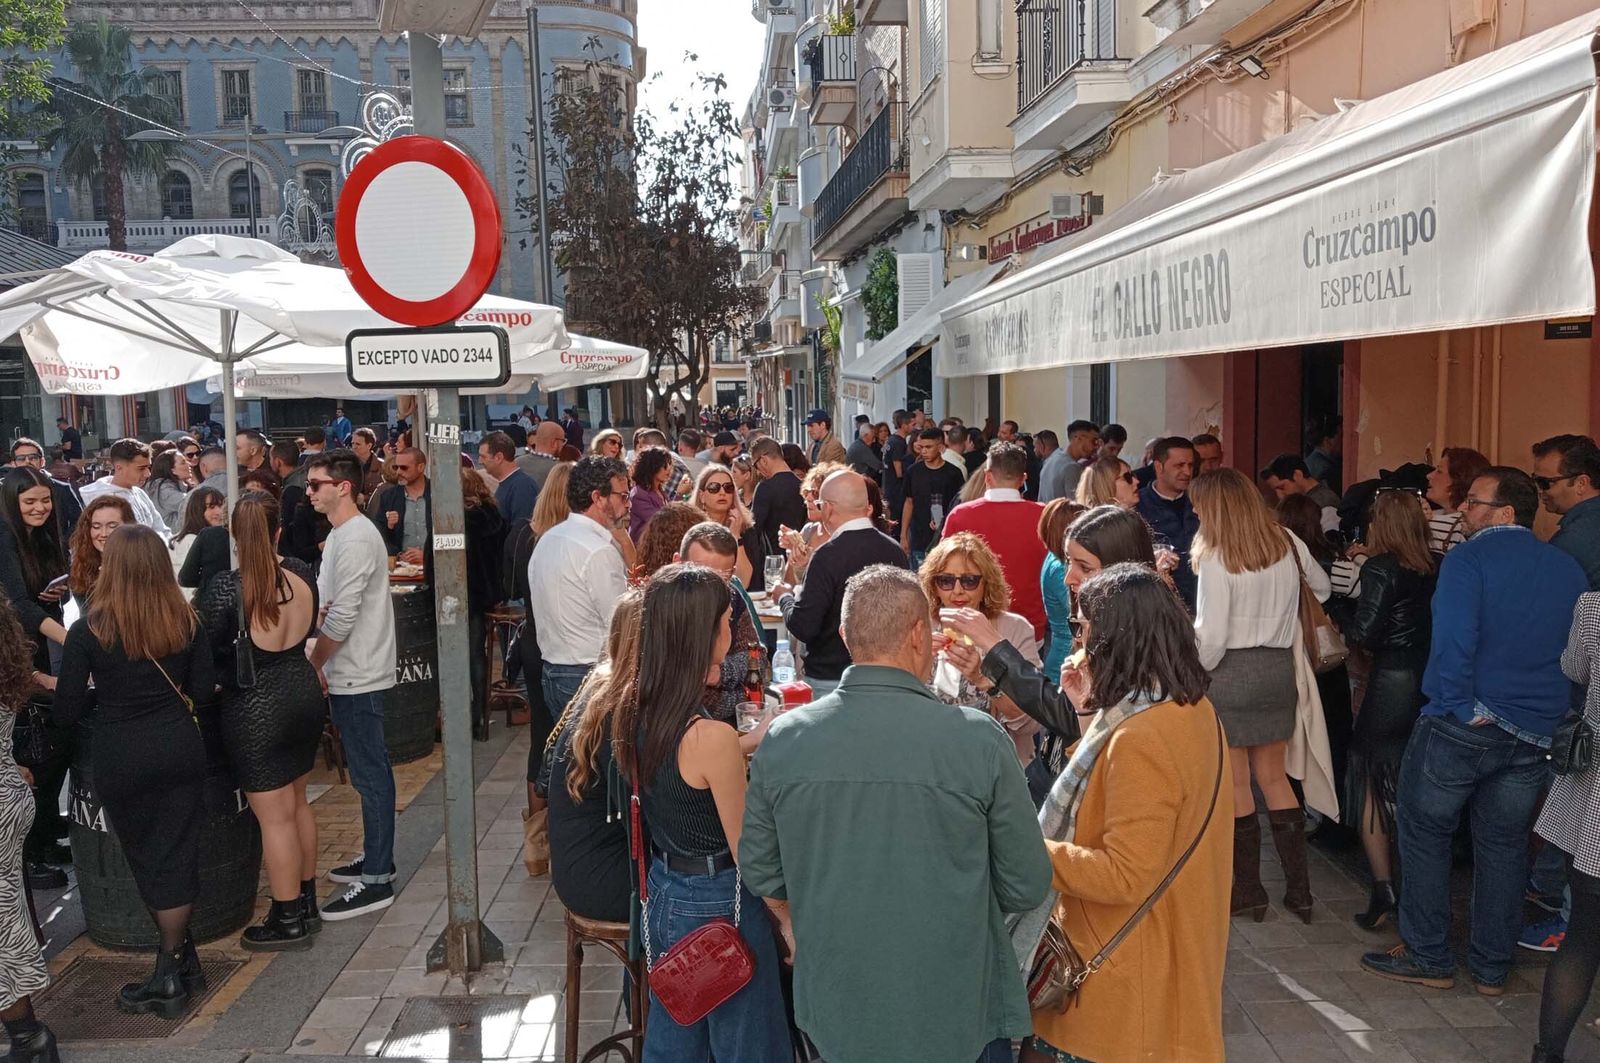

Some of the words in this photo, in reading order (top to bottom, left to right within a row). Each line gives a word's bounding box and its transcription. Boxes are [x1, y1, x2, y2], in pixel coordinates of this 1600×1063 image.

[1303, 206, 1437, 269] Cruzcampo
[1092, 285, 1108, 343] EL
[1113, 269, 1162, 340] GALLO
[1167, 247, 1232, 332] NEGRO
[1320, 264, 1412, 309] ESPECIAL
[456, 311, 532, 328] campo
[357, 349, 418, 366] EXCEPTO
[421, 348, 459, 364] VADO
[463, 347, 493, 363] 2344
